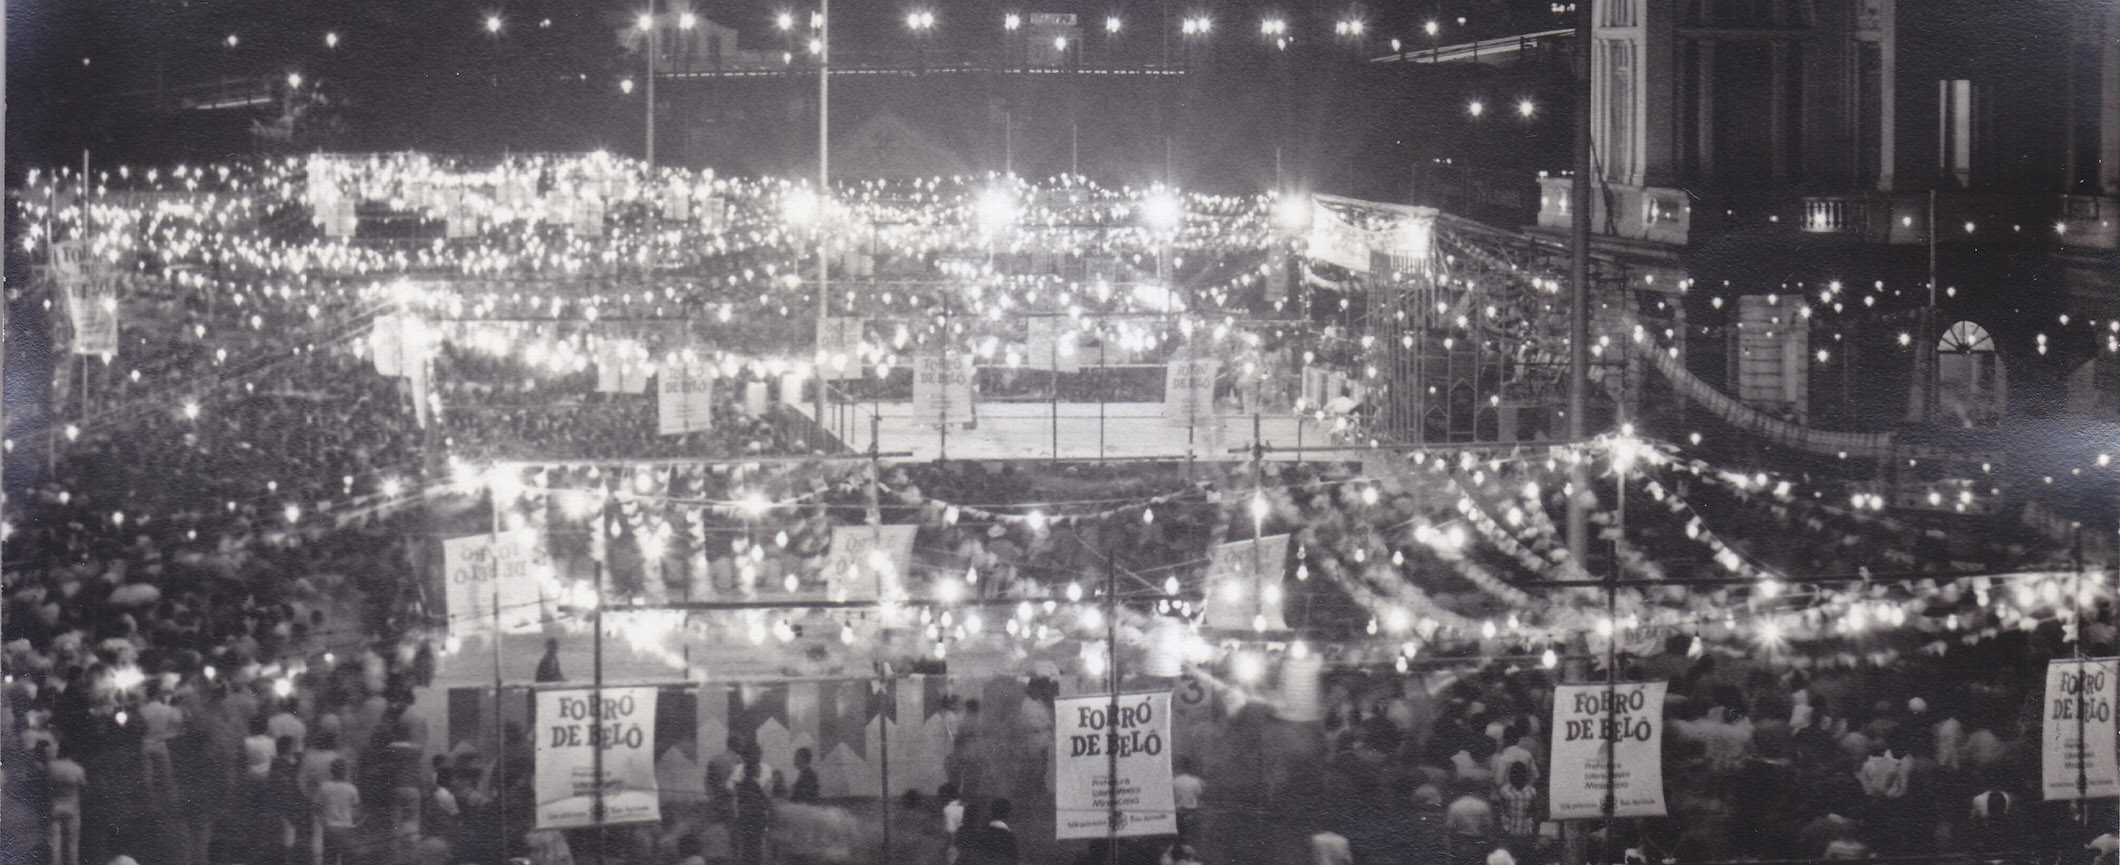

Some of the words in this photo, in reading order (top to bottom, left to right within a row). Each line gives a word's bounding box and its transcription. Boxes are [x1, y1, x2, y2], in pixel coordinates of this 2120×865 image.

[1180, 674, 1205, 705] 3
[2052, 697, 2073, 720] DE
[551, 724, 581, 749] DE
[1565, 718, 1594, 741] DE
[1070, 734, 1101, 758] DE
